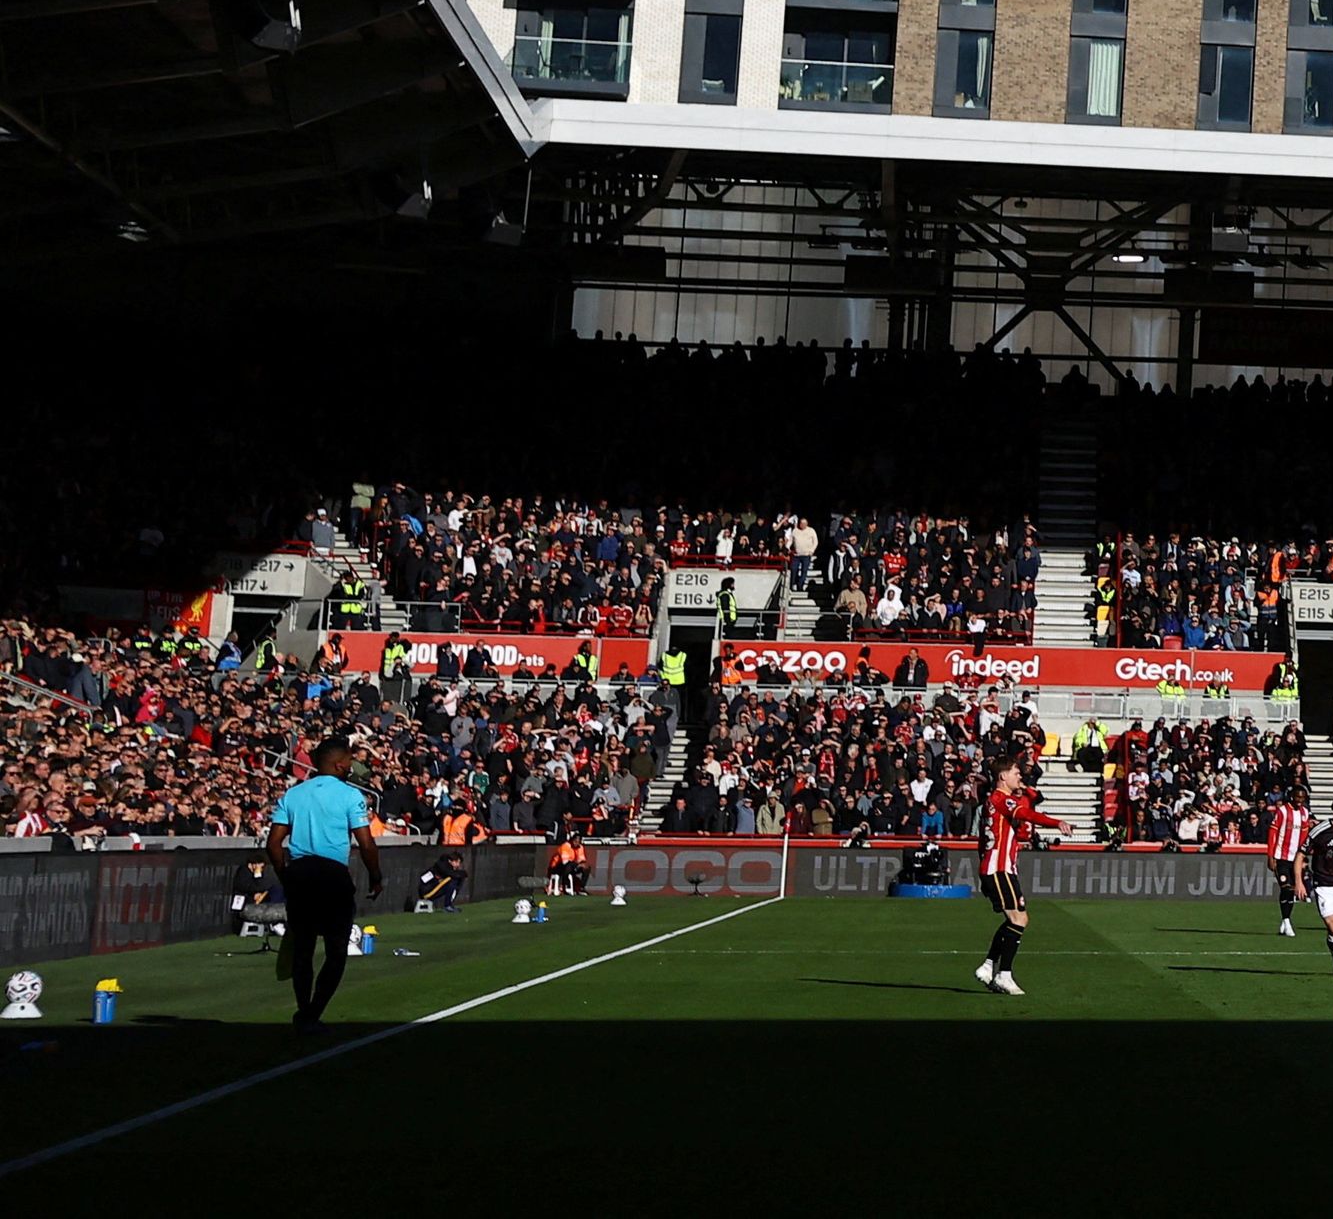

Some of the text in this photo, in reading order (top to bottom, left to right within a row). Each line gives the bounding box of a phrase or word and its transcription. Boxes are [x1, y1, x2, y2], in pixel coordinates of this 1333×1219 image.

[231, 579, 256, 591] E117
[676, 573, 709, 586] E216
[674, 594, 703, 606] E116
[1299, 588, 1330, 600] E215
[1298, 607, 1325, 619] E115
[945, 649, 1039, 678] indeed
[1032, 858, 1176, 897] LITHIUM
